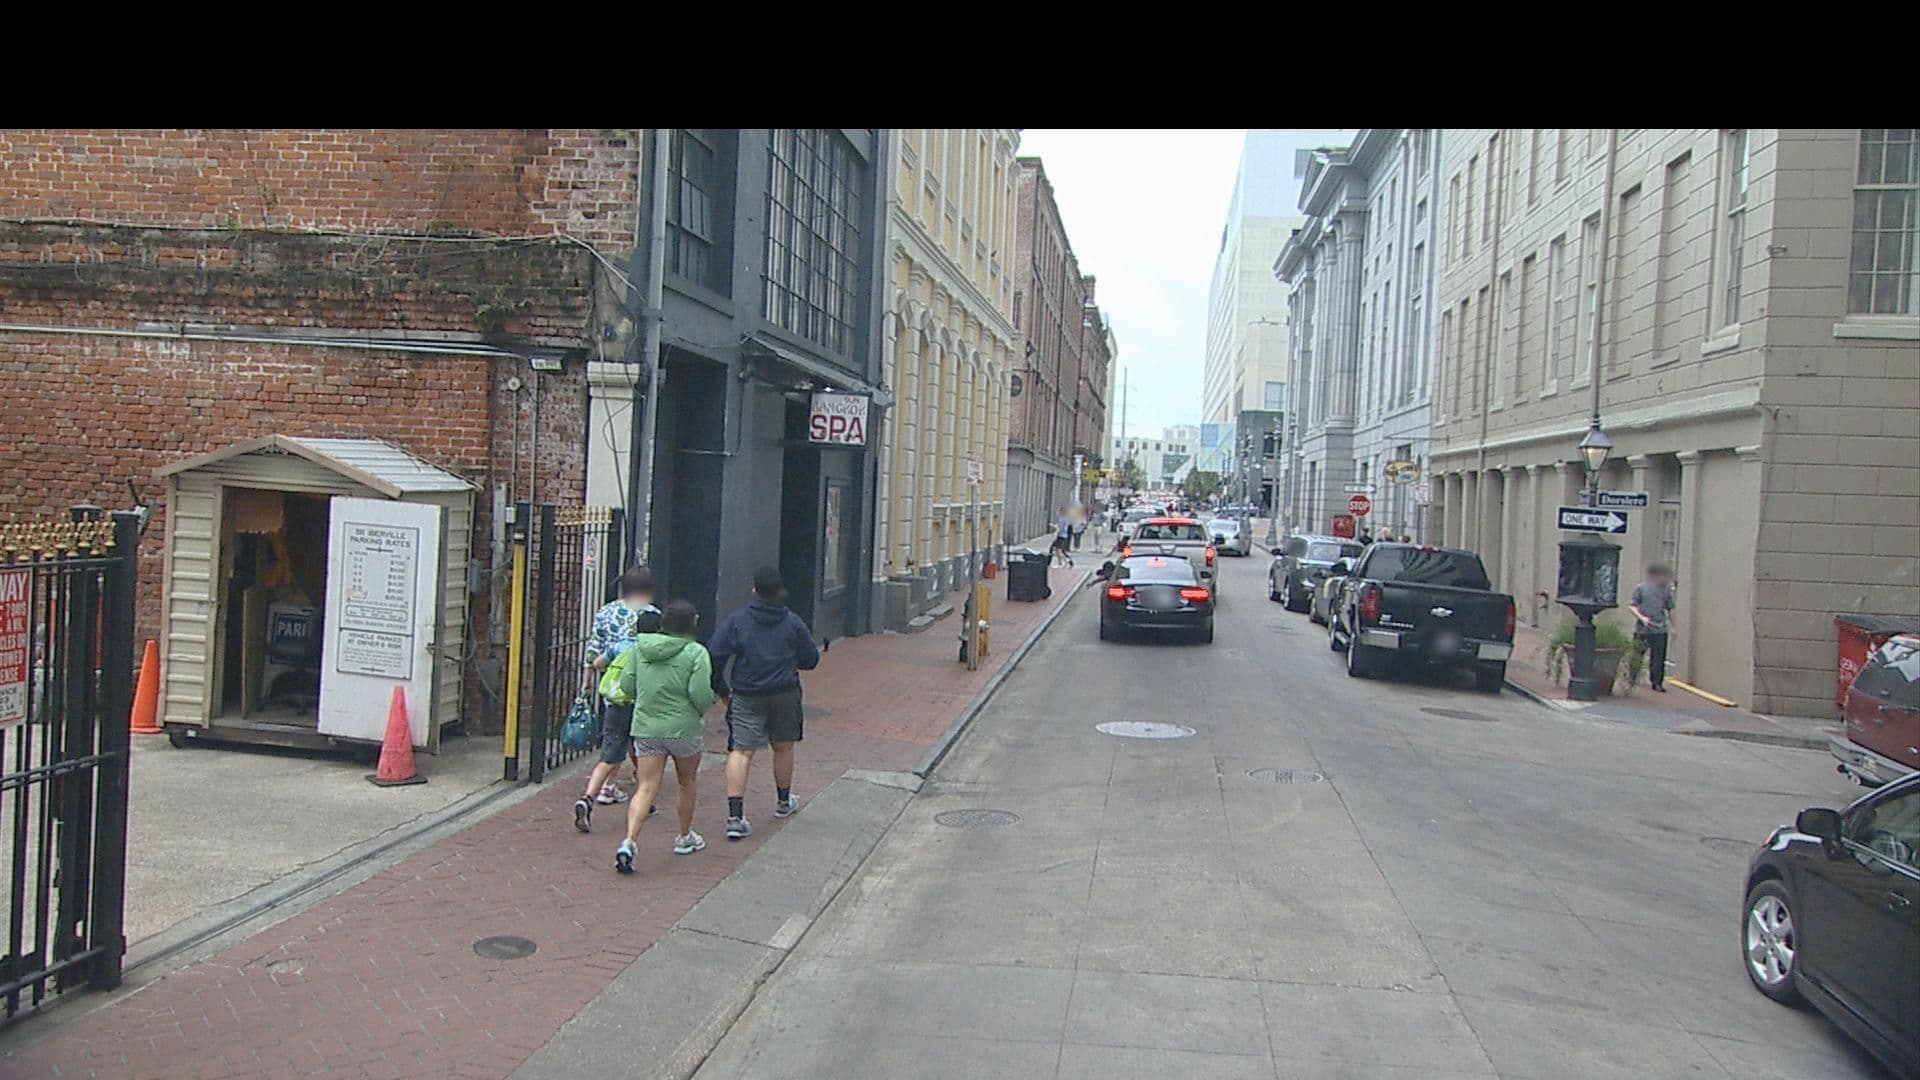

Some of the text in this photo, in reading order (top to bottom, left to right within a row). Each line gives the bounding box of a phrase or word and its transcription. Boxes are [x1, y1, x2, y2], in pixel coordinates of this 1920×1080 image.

[811, 415, 864, 443] SPA
[1349, 501, 1370, 511] STOP
[1564, 514, 1607, 526] ONE WAY
[350, 535, 411, 548] PARKING RATES
